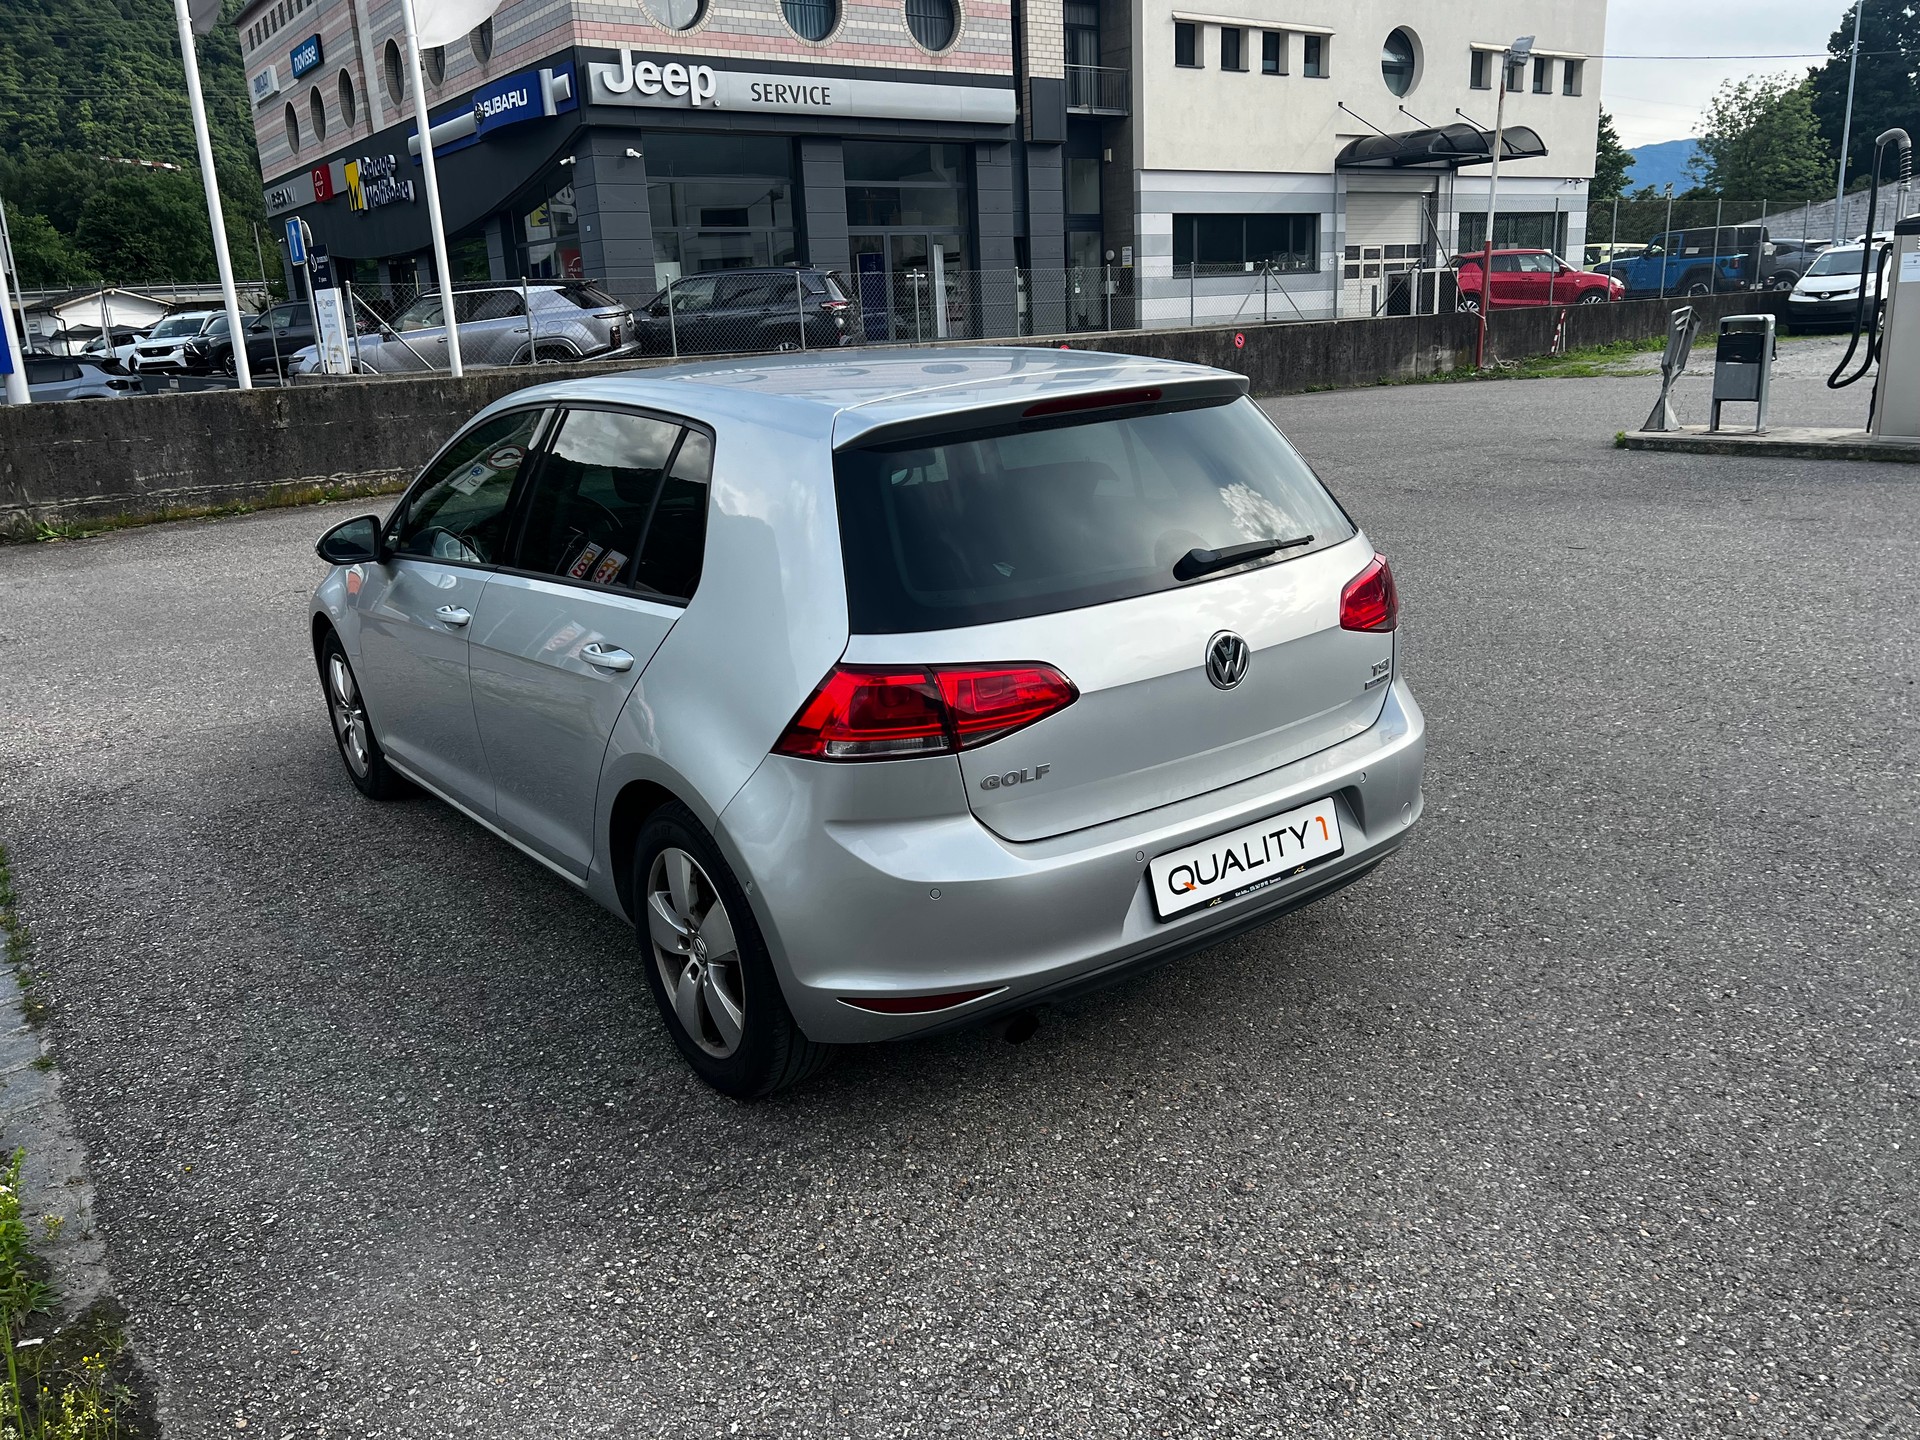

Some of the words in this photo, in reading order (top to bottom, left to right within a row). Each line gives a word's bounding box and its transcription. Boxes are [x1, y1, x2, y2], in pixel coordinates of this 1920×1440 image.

[293, 45, 317, 72] novisse
[602, 48, 717, 106] Jeep
[750, 82, 831, 106] SERVICE
[483, 88, 528, 117] SUBARU
[980, 762, 1051, 791] GOLF
[1168, 820, 1309, 895] QUALITY
[1315, 815, 1329, 841] 1
